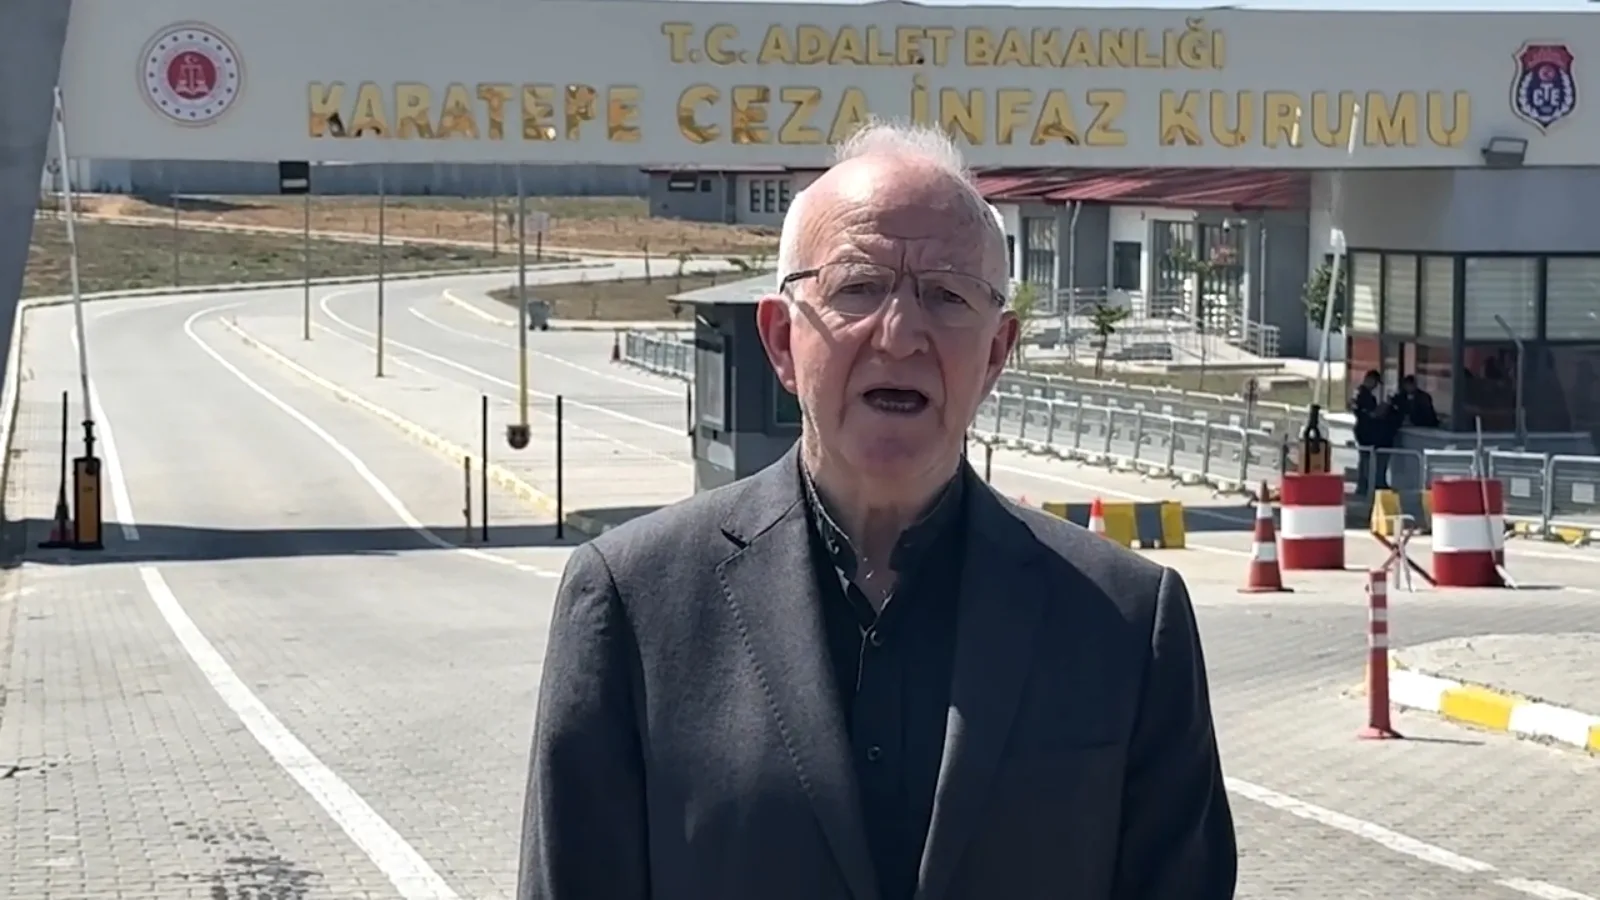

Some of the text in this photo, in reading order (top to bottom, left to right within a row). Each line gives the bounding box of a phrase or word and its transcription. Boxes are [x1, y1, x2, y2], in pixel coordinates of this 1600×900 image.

[661, 22, 747, 65] T.C.
[964, 18, 1225, 69] BAKANLIĞI
[308, 74, 1472, 147] KARATEPE CEZA İNFAZ KURUMU
